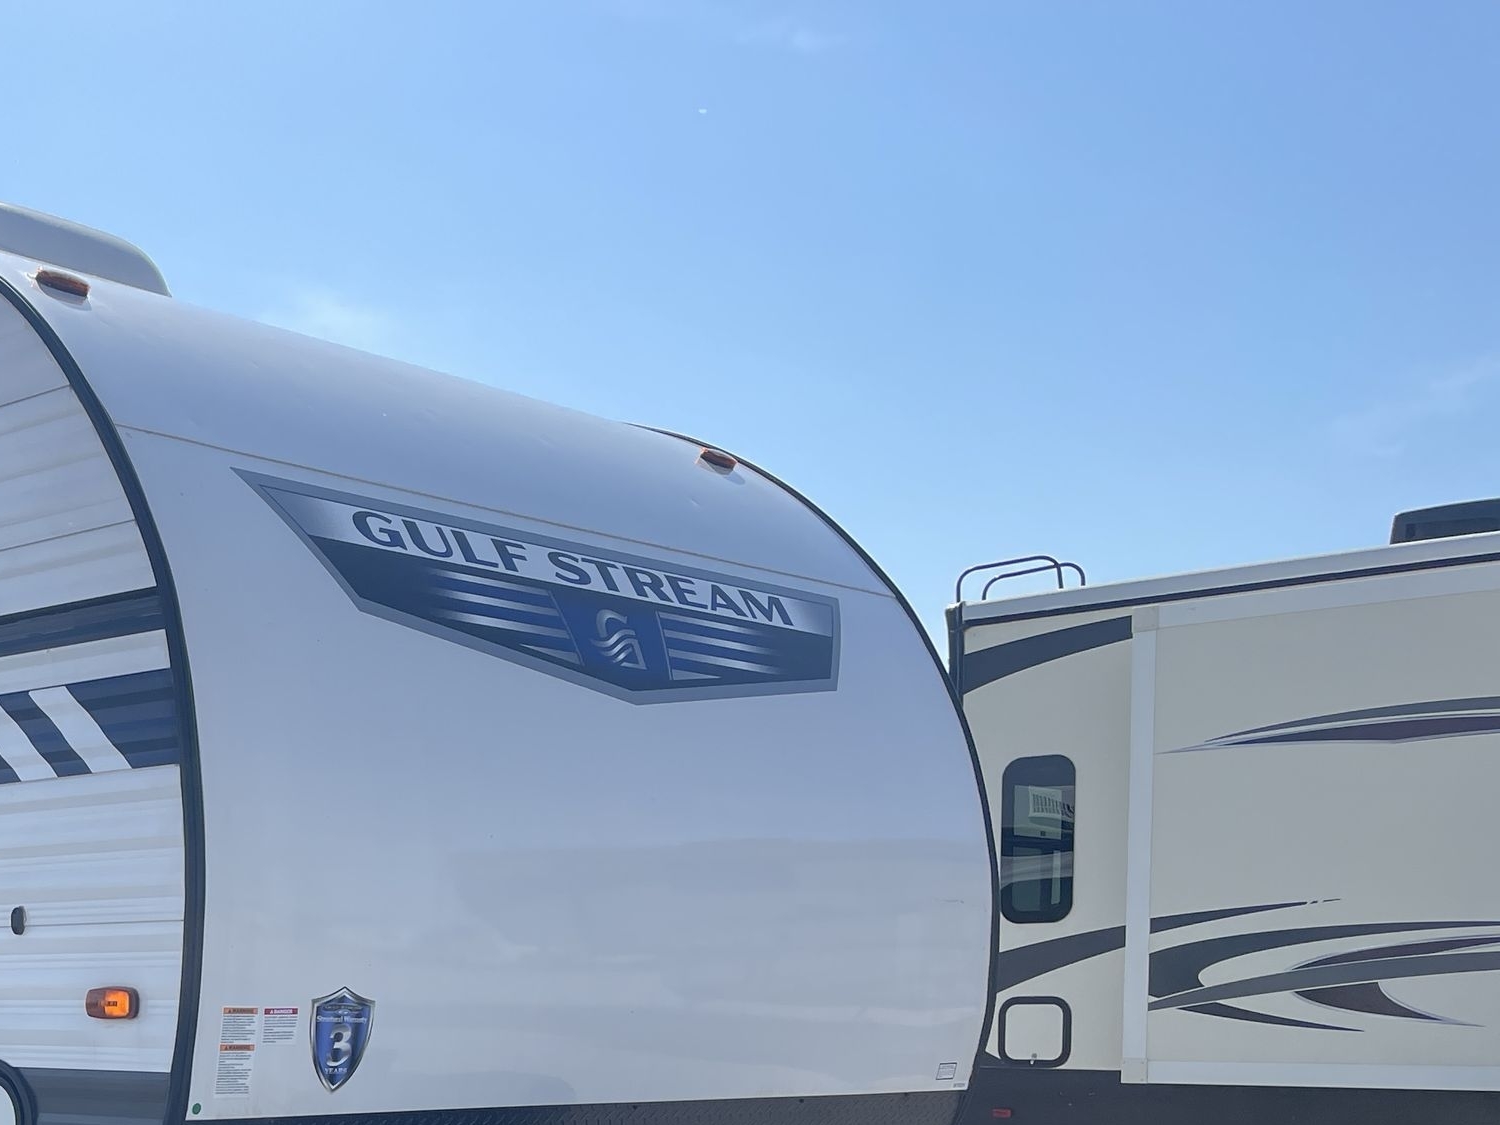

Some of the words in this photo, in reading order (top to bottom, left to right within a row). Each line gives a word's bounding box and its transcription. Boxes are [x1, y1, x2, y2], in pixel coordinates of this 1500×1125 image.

[352, 510, 529, 574] GULF
[547, 551, 794, 627] STREAM
[326, 1023, 352, 1067] 3
[324, 1067, 348, 1075] YEARS
